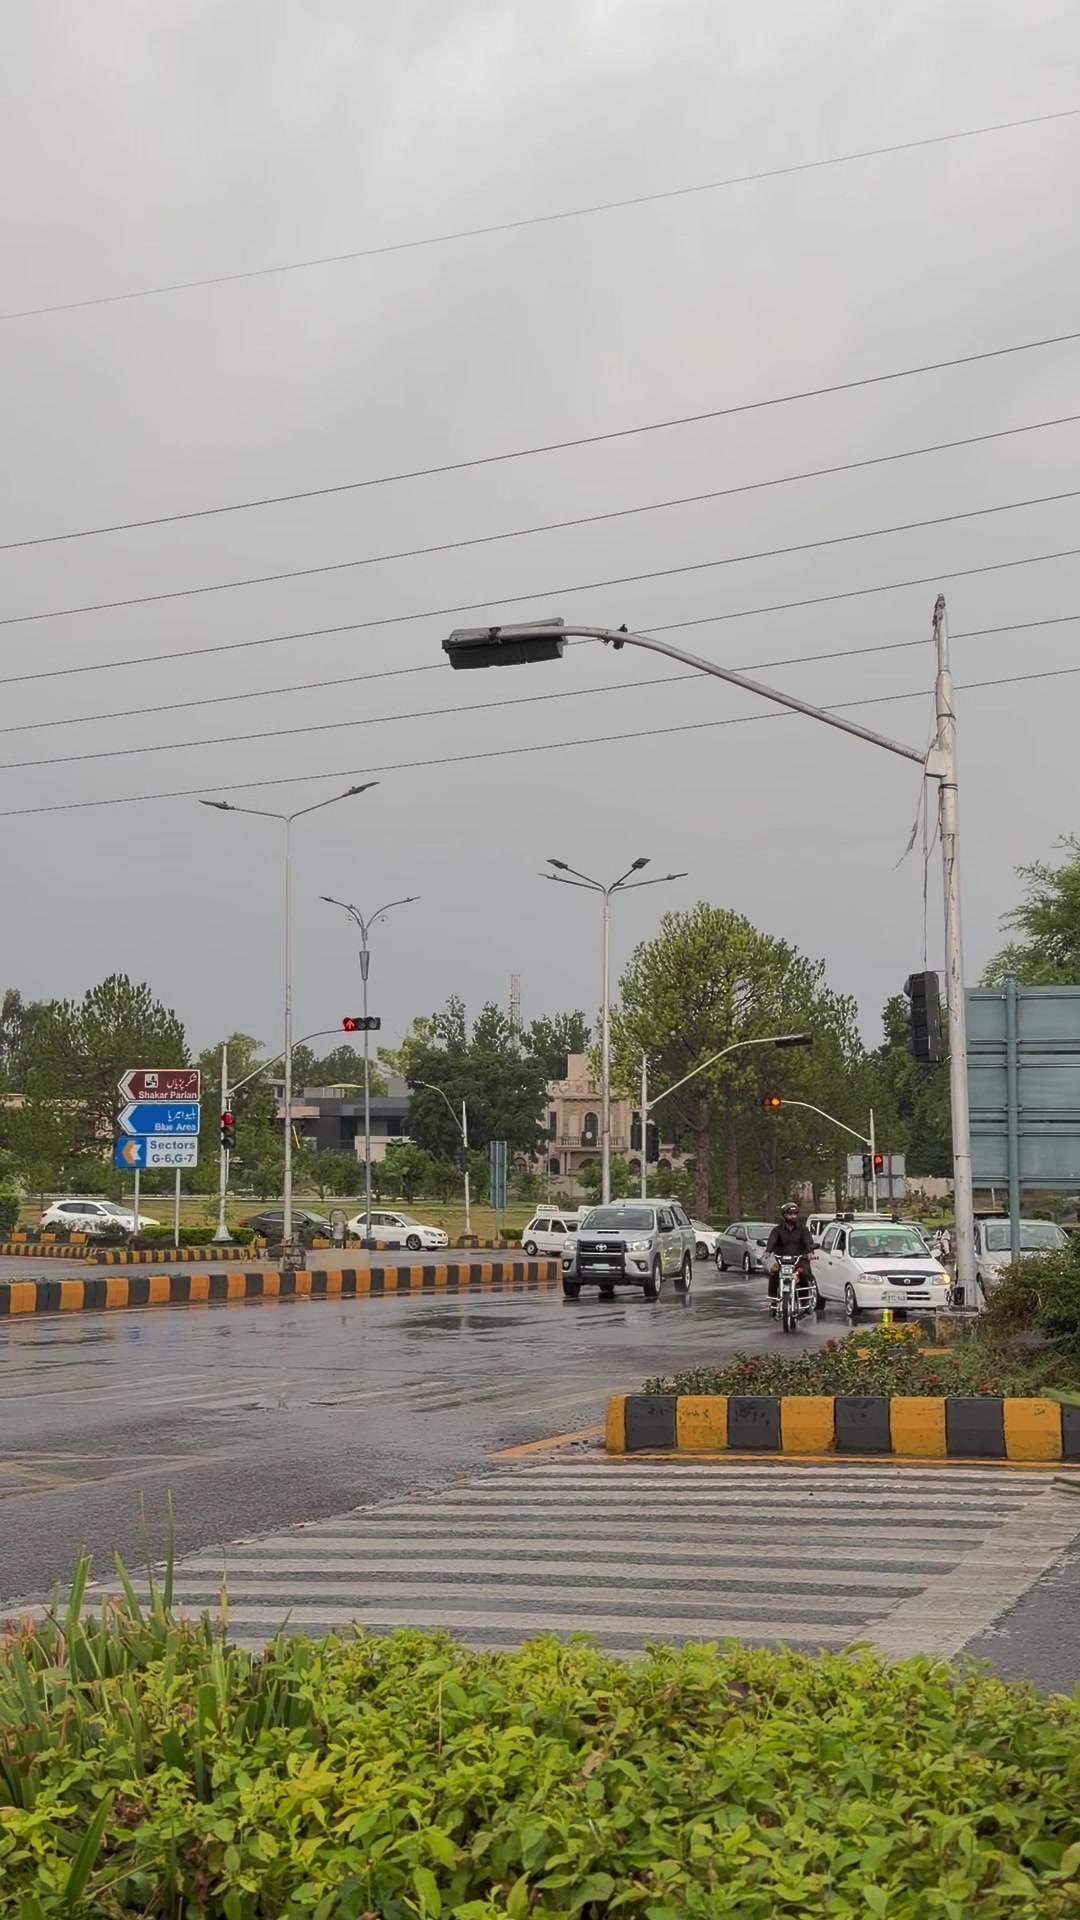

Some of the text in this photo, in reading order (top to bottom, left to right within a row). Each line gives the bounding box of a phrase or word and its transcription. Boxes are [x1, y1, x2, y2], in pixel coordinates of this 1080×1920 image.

[139, 1091, 197, 1099] Shakar Parian
[155, 1123, 196, 1131] Blue Area
[150, 1140, 195, 1150] Sectors
[152, 1154, 194, 1164] G-6,G-7
